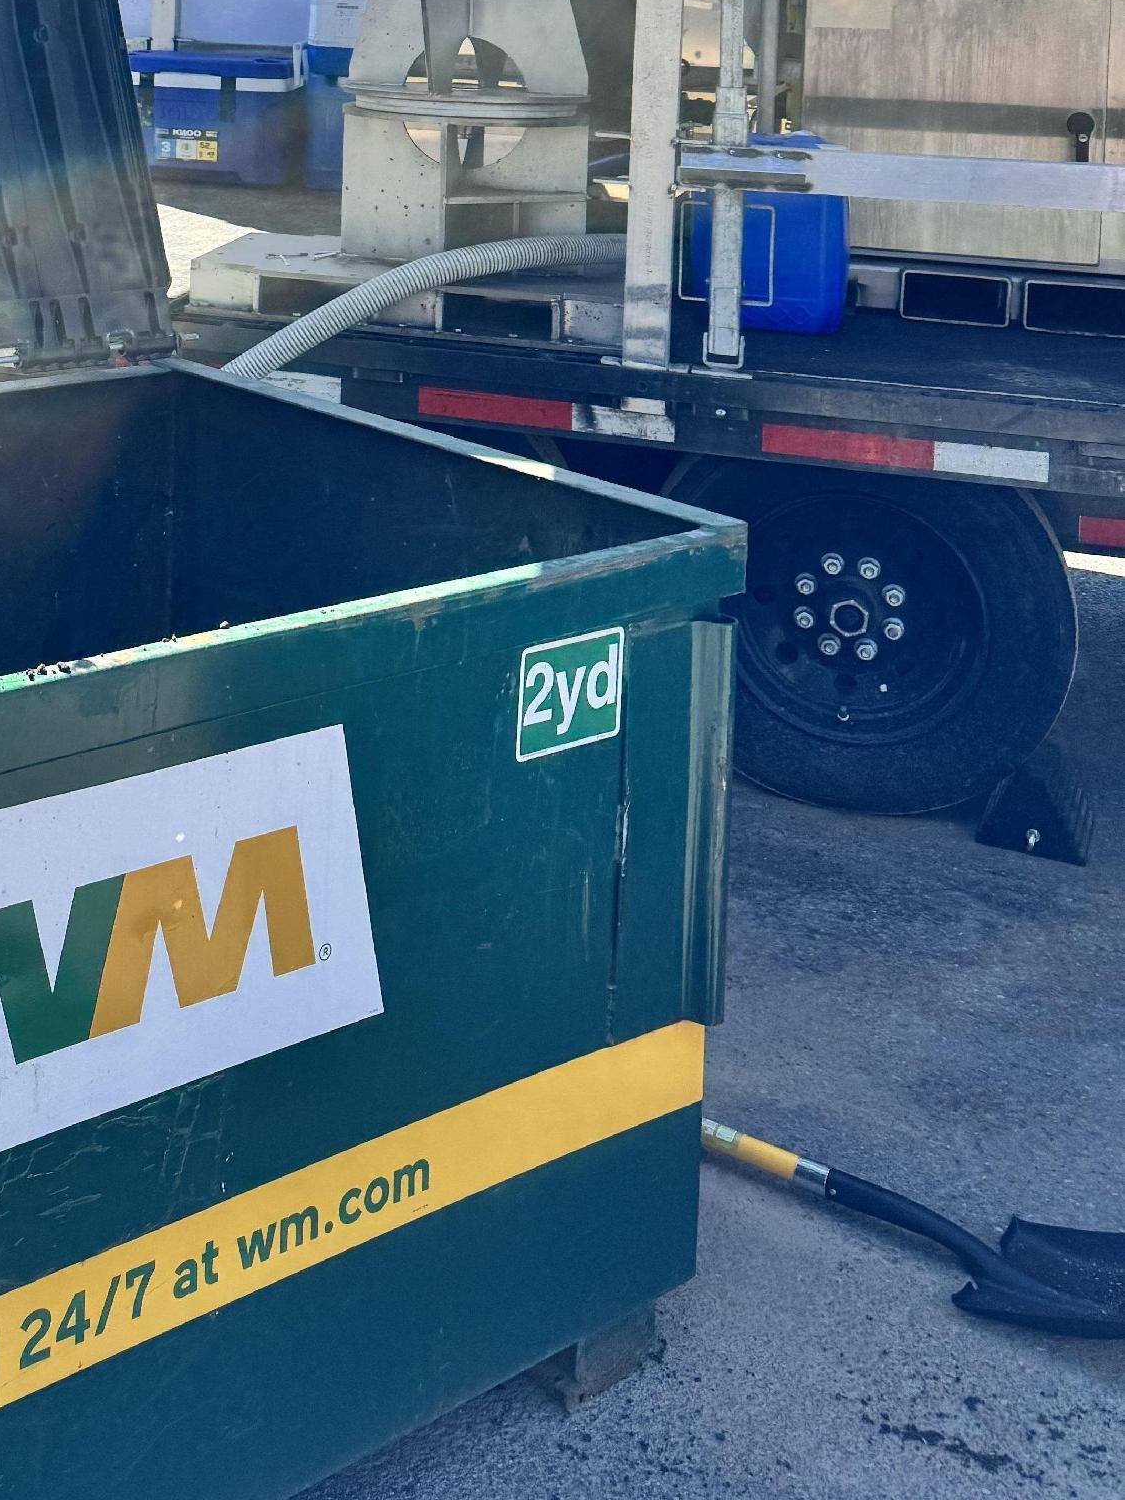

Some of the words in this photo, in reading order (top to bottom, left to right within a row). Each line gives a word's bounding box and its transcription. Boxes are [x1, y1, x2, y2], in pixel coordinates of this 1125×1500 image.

[523, 643, 618, 735] 2yd
[19, 1260, 156, 1370] 24/7
[173, 1240, 219, 1299] at
[236, 1158, 430, 1270] wm.com
